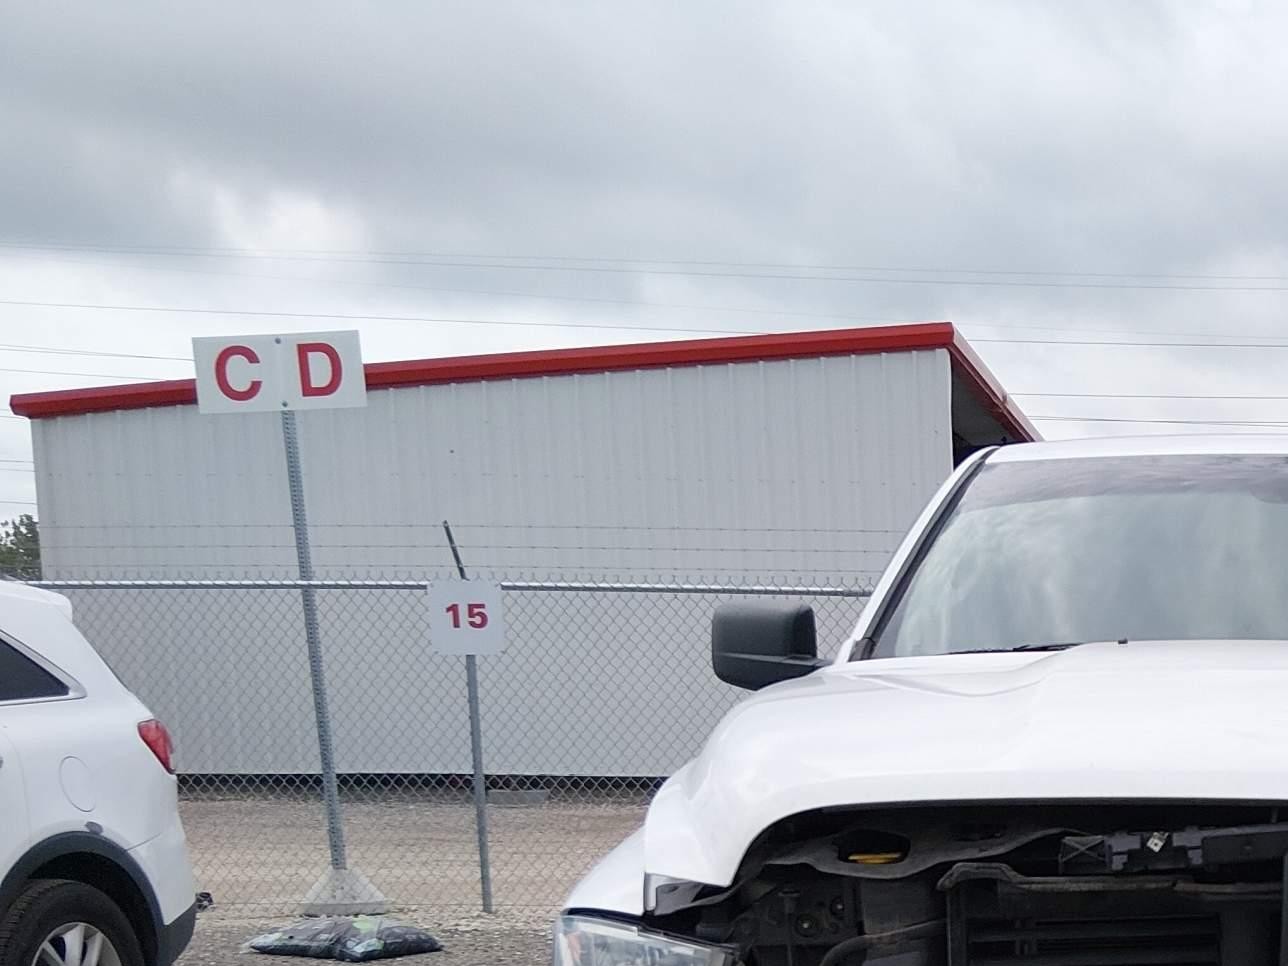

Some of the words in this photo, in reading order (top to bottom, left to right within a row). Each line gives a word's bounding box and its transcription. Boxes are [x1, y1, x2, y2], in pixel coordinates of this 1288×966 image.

[215, 346, 262, 401] C
[297, 342, 342, 397] D
[444, 601, 489, 630] 15
